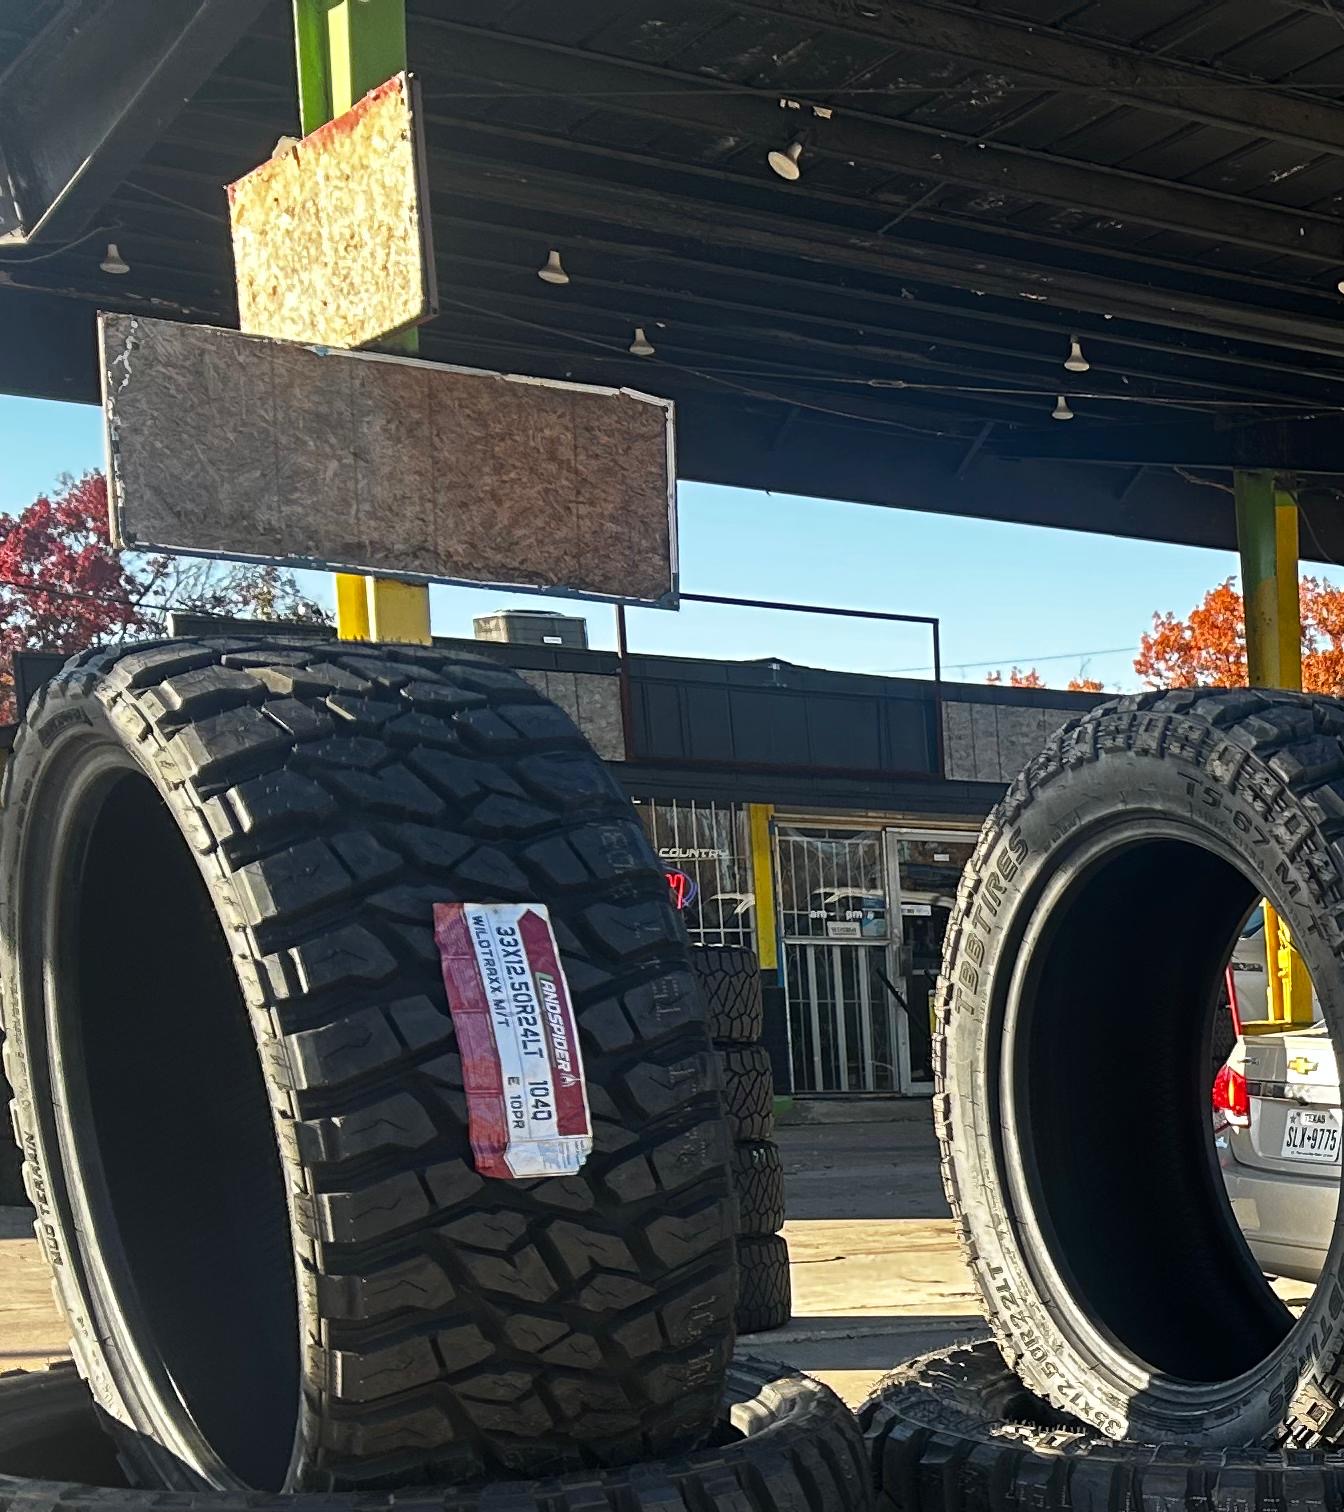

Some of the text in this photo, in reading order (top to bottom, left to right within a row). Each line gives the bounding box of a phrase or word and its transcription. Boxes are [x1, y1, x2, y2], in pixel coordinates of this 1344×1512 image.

[659, 847, 729, 858] COUNTRY
[973, 825, 1030, 934] TIRES
[471, 915, 525, 1129] WILDTRAXX M/T E 10PR
[496, 926, 544, 1058] 33X12.50R24LT
[535, 971, 571, 1073] LANDSPIDER
[1305, 1113, 1326, 1124] TEXAS
